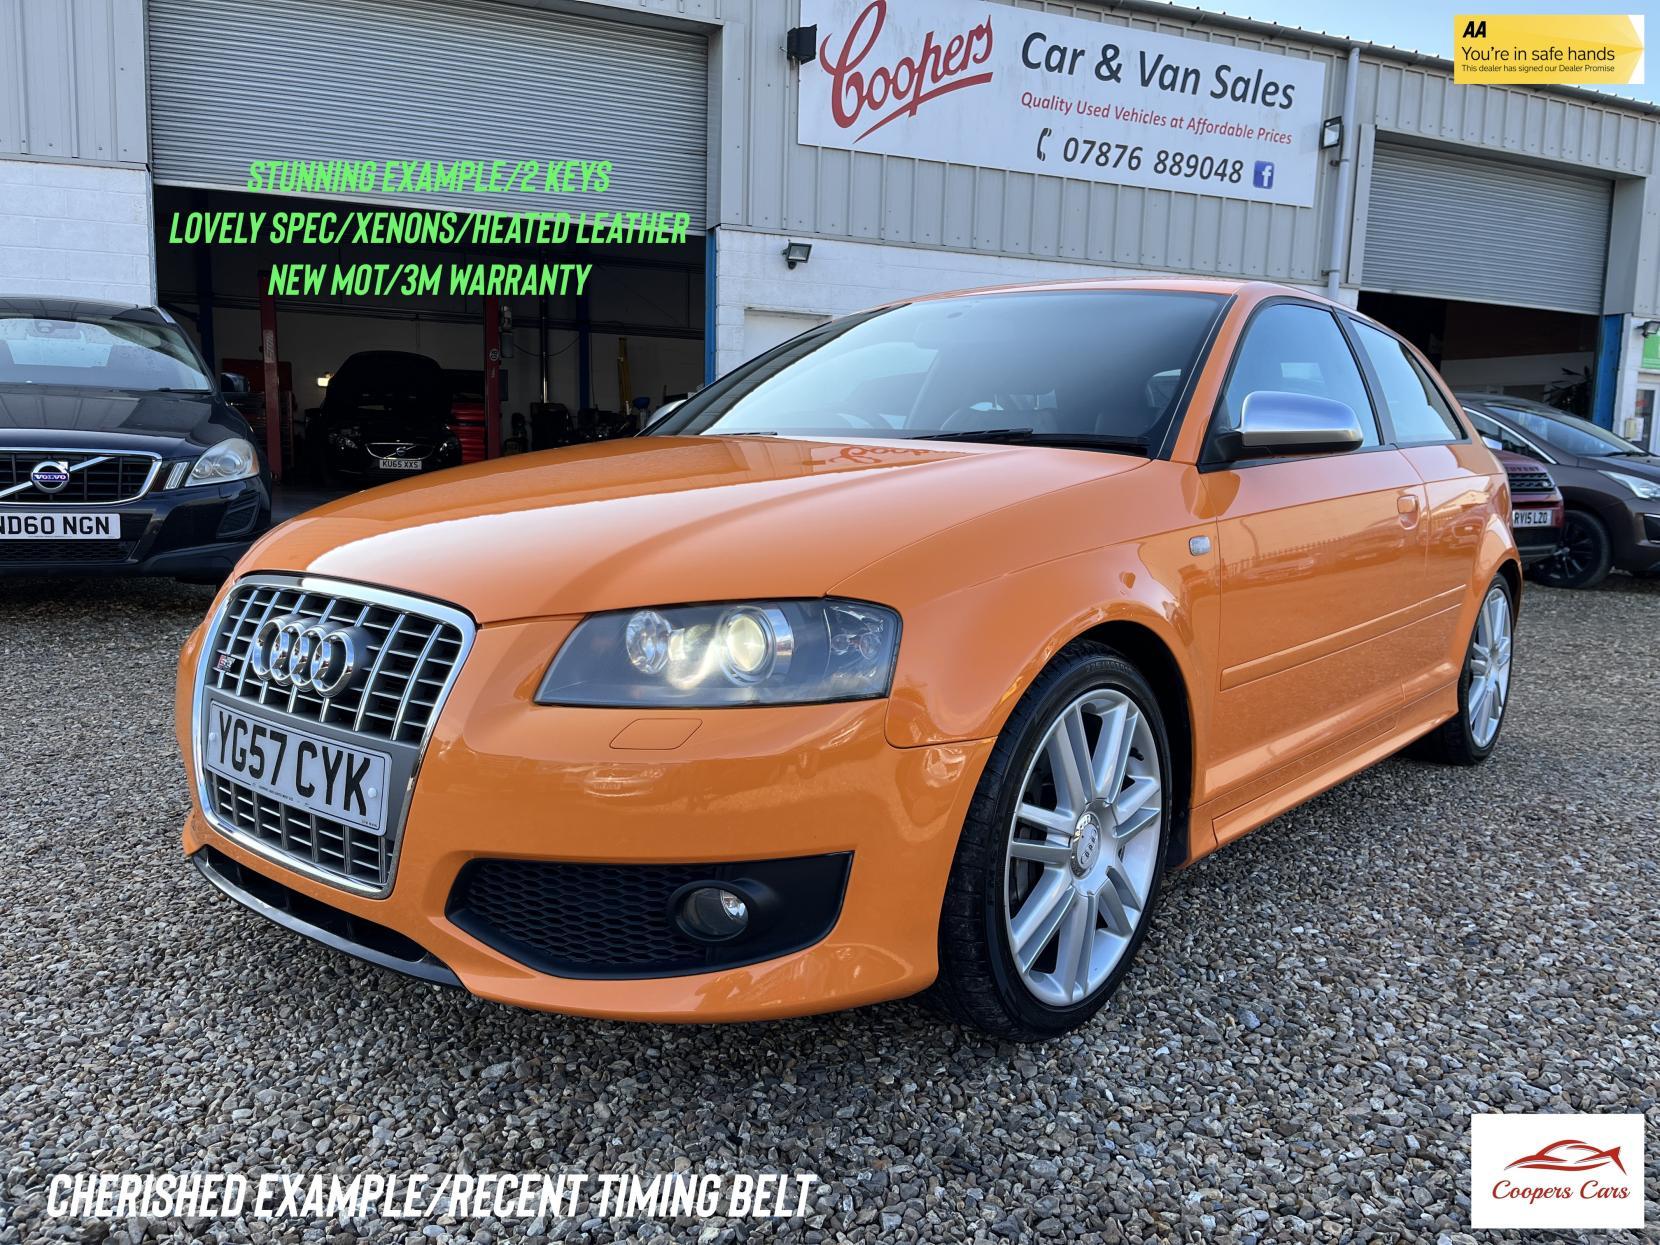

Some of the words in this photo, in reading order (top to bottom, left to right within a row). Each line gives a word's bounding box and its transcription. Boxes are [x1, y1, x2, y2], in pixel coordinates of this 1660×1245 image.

[819, 0, 994, 131] Coopers
[1021, 32, 1085, 76] Car
[1094, 43, 1122, 84] &
[1139, 50, 1200, 95] Van
[1210, 64, 1296, 110] Sales
[1021, 91, 1073, 116] Quality
[1076, 100, 1110, 118] Used
[1114, 105, 1167, 127] Vehicles
[1170, 117, 1184, 130] at
[1186, 117, 1254, 140] Affordable
[1257, 127, 1292, 145] Prices
[1063, 137, 1144, 171] 07876
[1153, 150, 1245, 184] 889048
[62, 516, 110, 535] NGN
[218, 710, 288, 786] YG57
[296, 740, 372, 817] CYK
